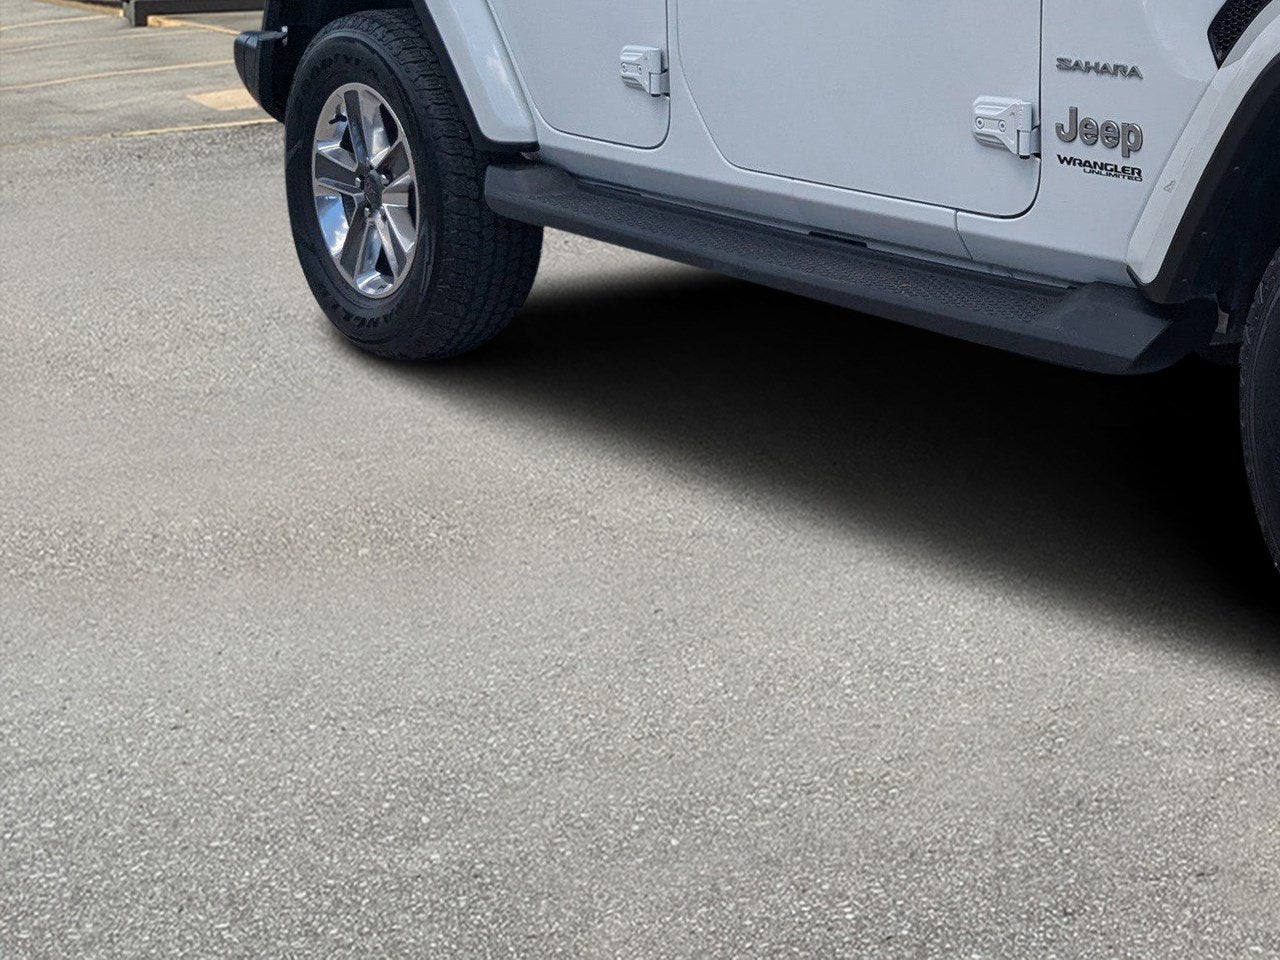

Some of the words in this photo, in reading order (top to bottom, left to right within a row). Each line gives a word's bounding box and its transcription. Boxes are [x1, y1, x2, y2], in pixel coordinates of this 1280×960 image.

[1056, 57, 1143, 80] SAHARA
[1055, 106, 1143, 158] Jeep
[1057, 154, 1142, 177] WRANGLER
[1083, 168, 1142, 182] UNLIMITED
